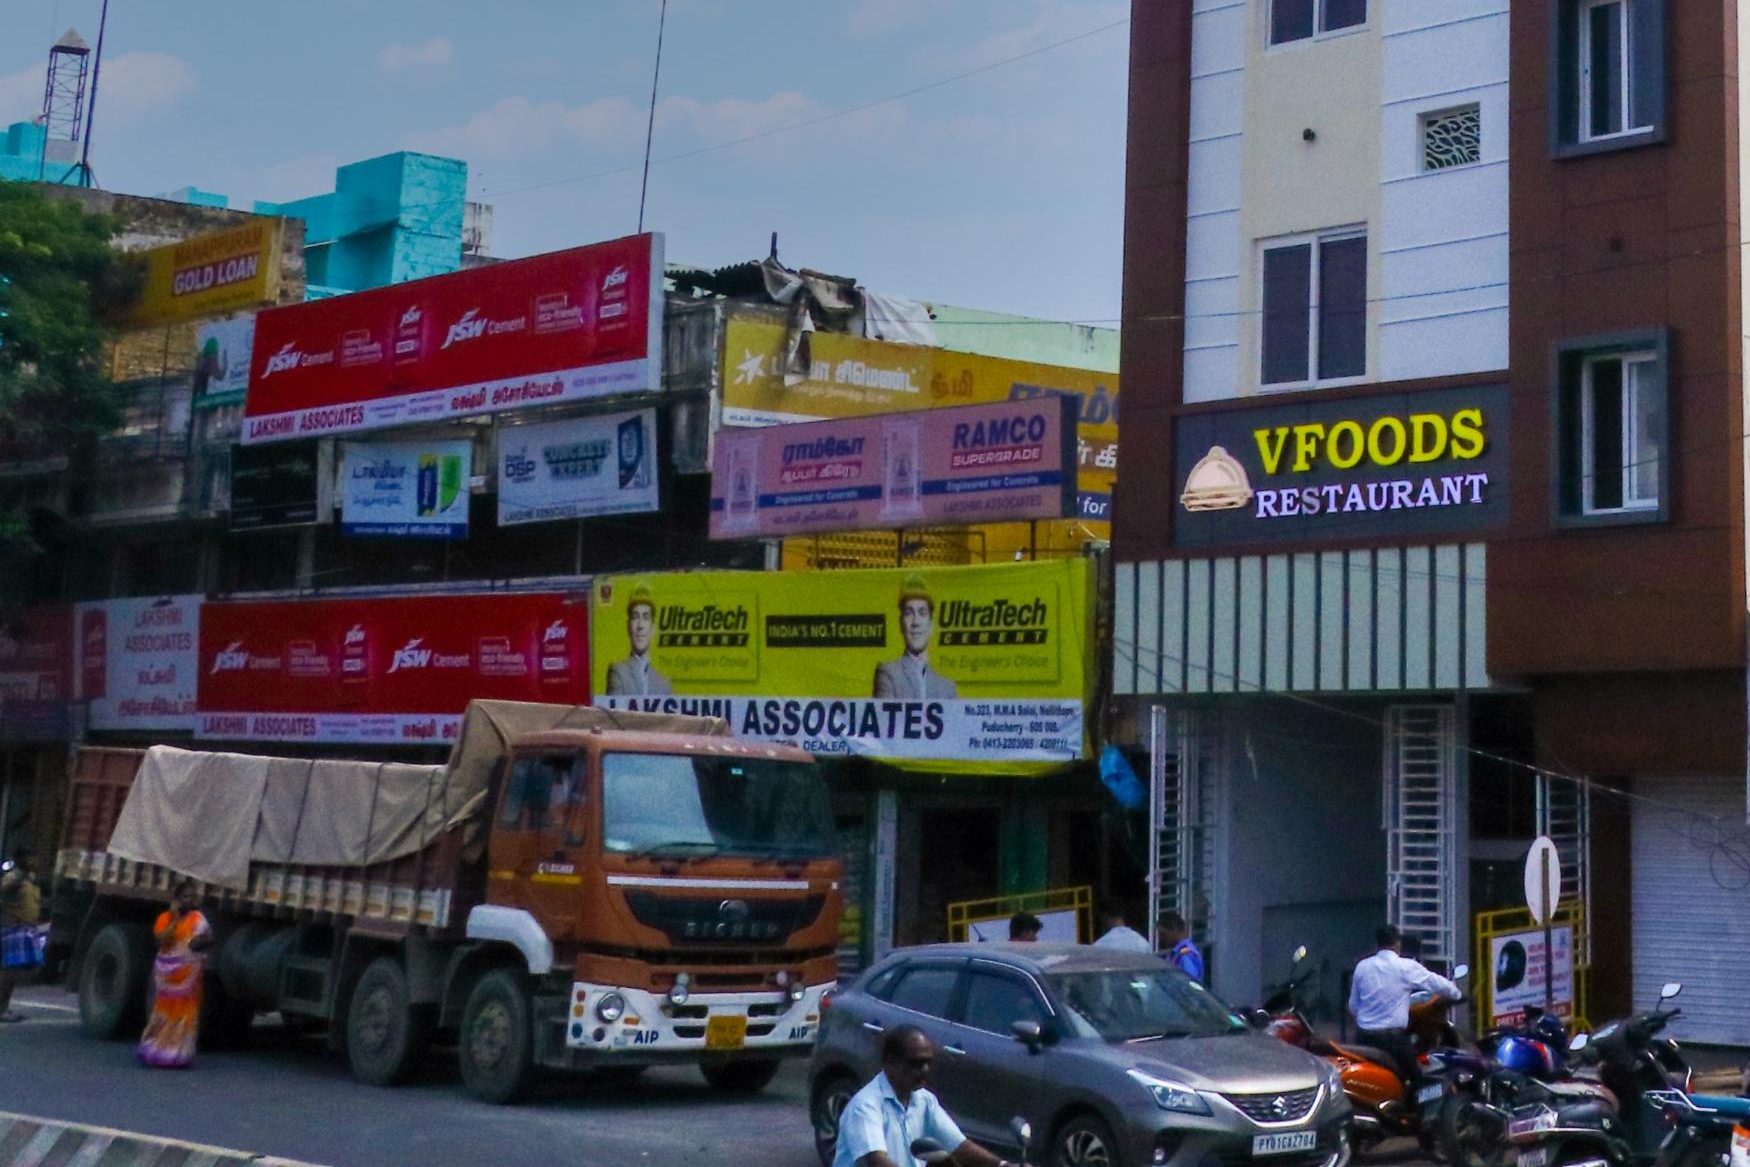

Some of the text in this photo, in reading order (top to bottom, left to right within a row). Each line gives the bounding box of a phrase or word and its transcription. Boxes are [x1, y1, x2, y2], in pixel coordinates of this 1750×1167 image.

[174, 253, 259, 296] GOLD LOAN
[440, 308, 488, 350] JSW
[488, 316, 526, 335] Cement
[260, 341, 302, 379] JSW
[250, 415, 296, 439] LAKSHMI
[299, 405, 365, 430] ASSOCIATES
[952, 414, 1046, 450] RAMCO
[1253, 408, 1486, 476] VFOODS
[505, 460, 536, 478] DSP
[952, 447, 1041, 467] SUPERGRADE
[1083, 497, 1108, 515] for
[1254, 472, 1489, 519] RESTAURANT
[134, 607, 183, 628] LAKSHMI
[658, 605, 749, 631] UltraTech
[938, 598, 1047, 629] UltraTech
[124, 632, 192, 653] ASSOCIATES
[769, 625, 807, 639] INDIA'S
[838, 623, 884, 638] CEMENT
[386, 637, 432, 674] JSW
[432, 653, 469, 667] Cement
[204, 717, 248, 734] LAKSHMI
[251, 717, 316, 736] ASSOCIATES
[742, 700, 945, 740] ASSOCIATES
[686, 921, 780, 938] EICHER
[634, 1030, 659, 1045] AIP
[788, 1026, 809, 1041] AIP
